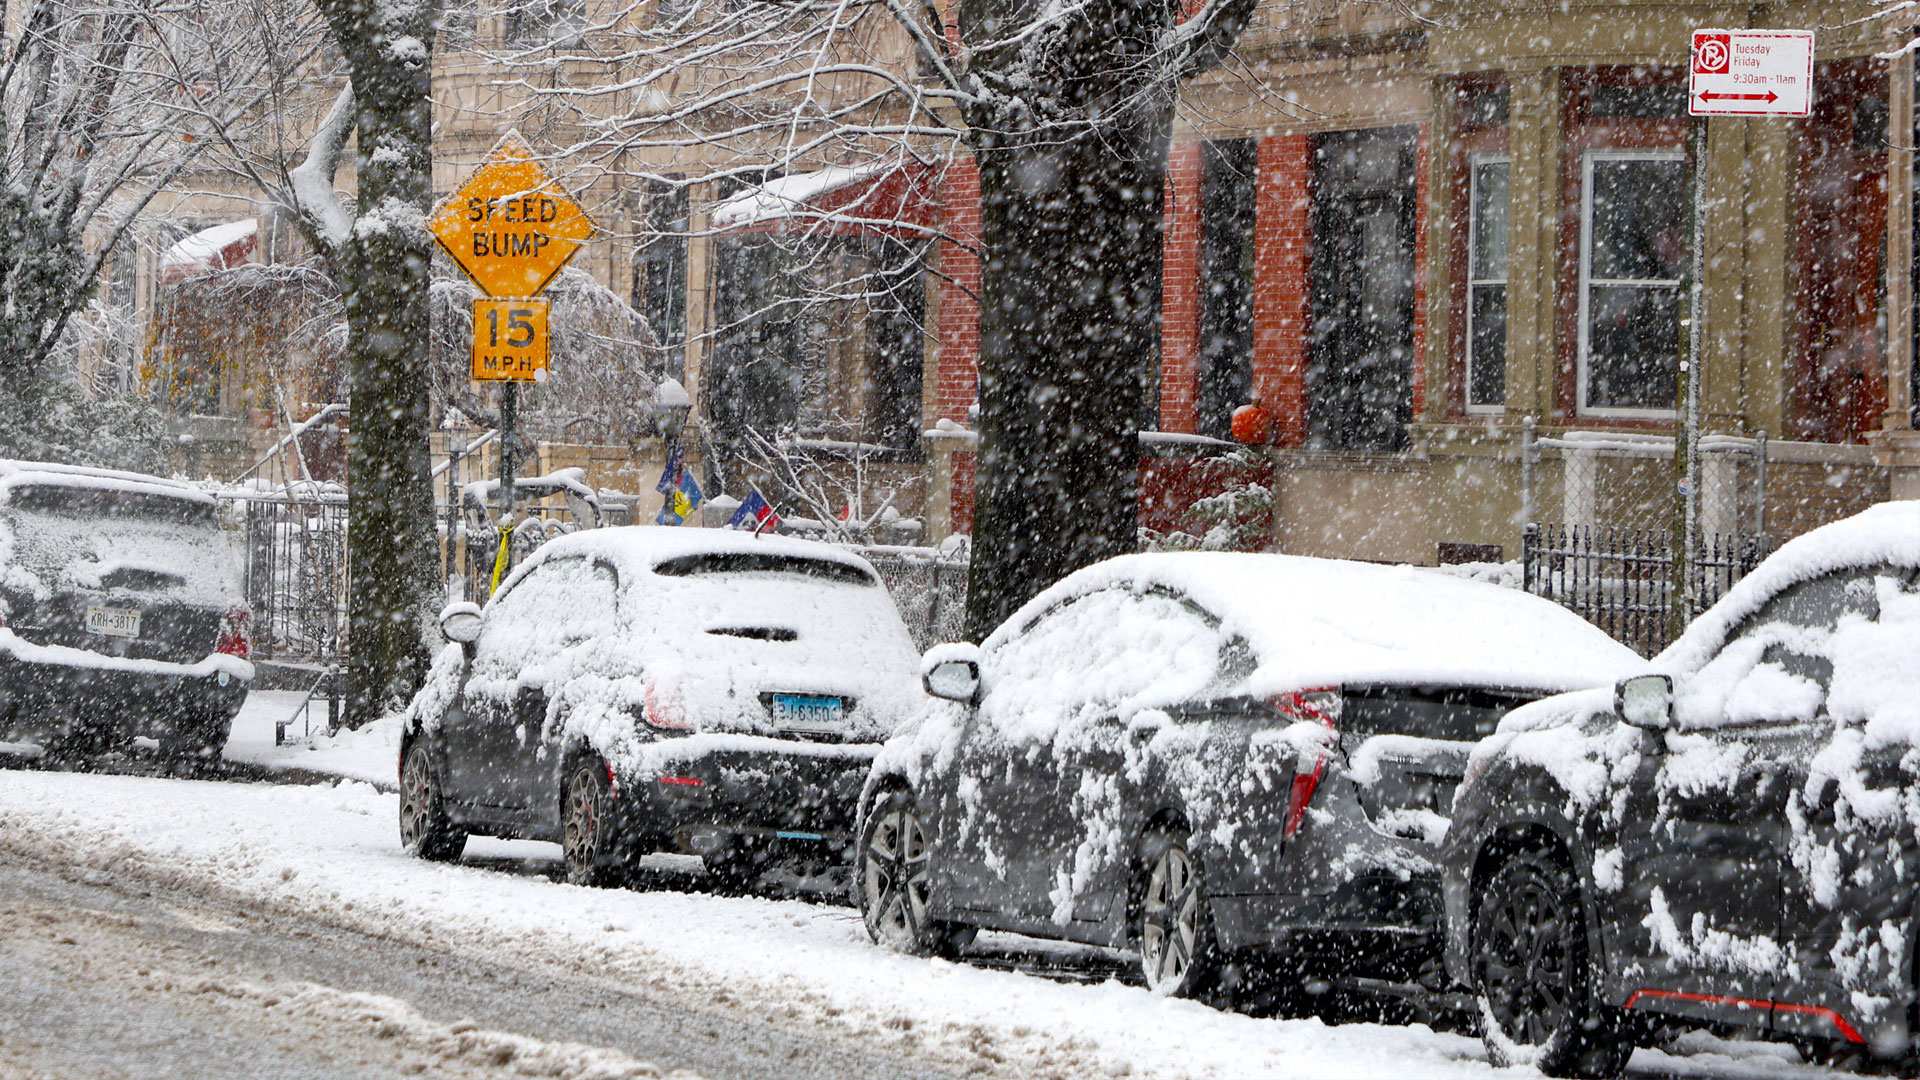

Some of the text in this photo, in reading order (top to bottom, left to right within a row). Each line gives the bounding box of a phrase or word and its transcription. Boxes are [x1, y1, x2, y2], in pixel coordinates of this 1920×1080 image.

[1736, 43, 1771, 55] Tuesday
[1733, 56, 1760, 68] Friday
[1733, 73, 1767, 84] 9:30am
[1776, 74, 1796, 85] 11am
[468, 197, 558, 223] SPEED
[473, 232, 550, 258] BUMP
[486, 308, 536, 349] 15
